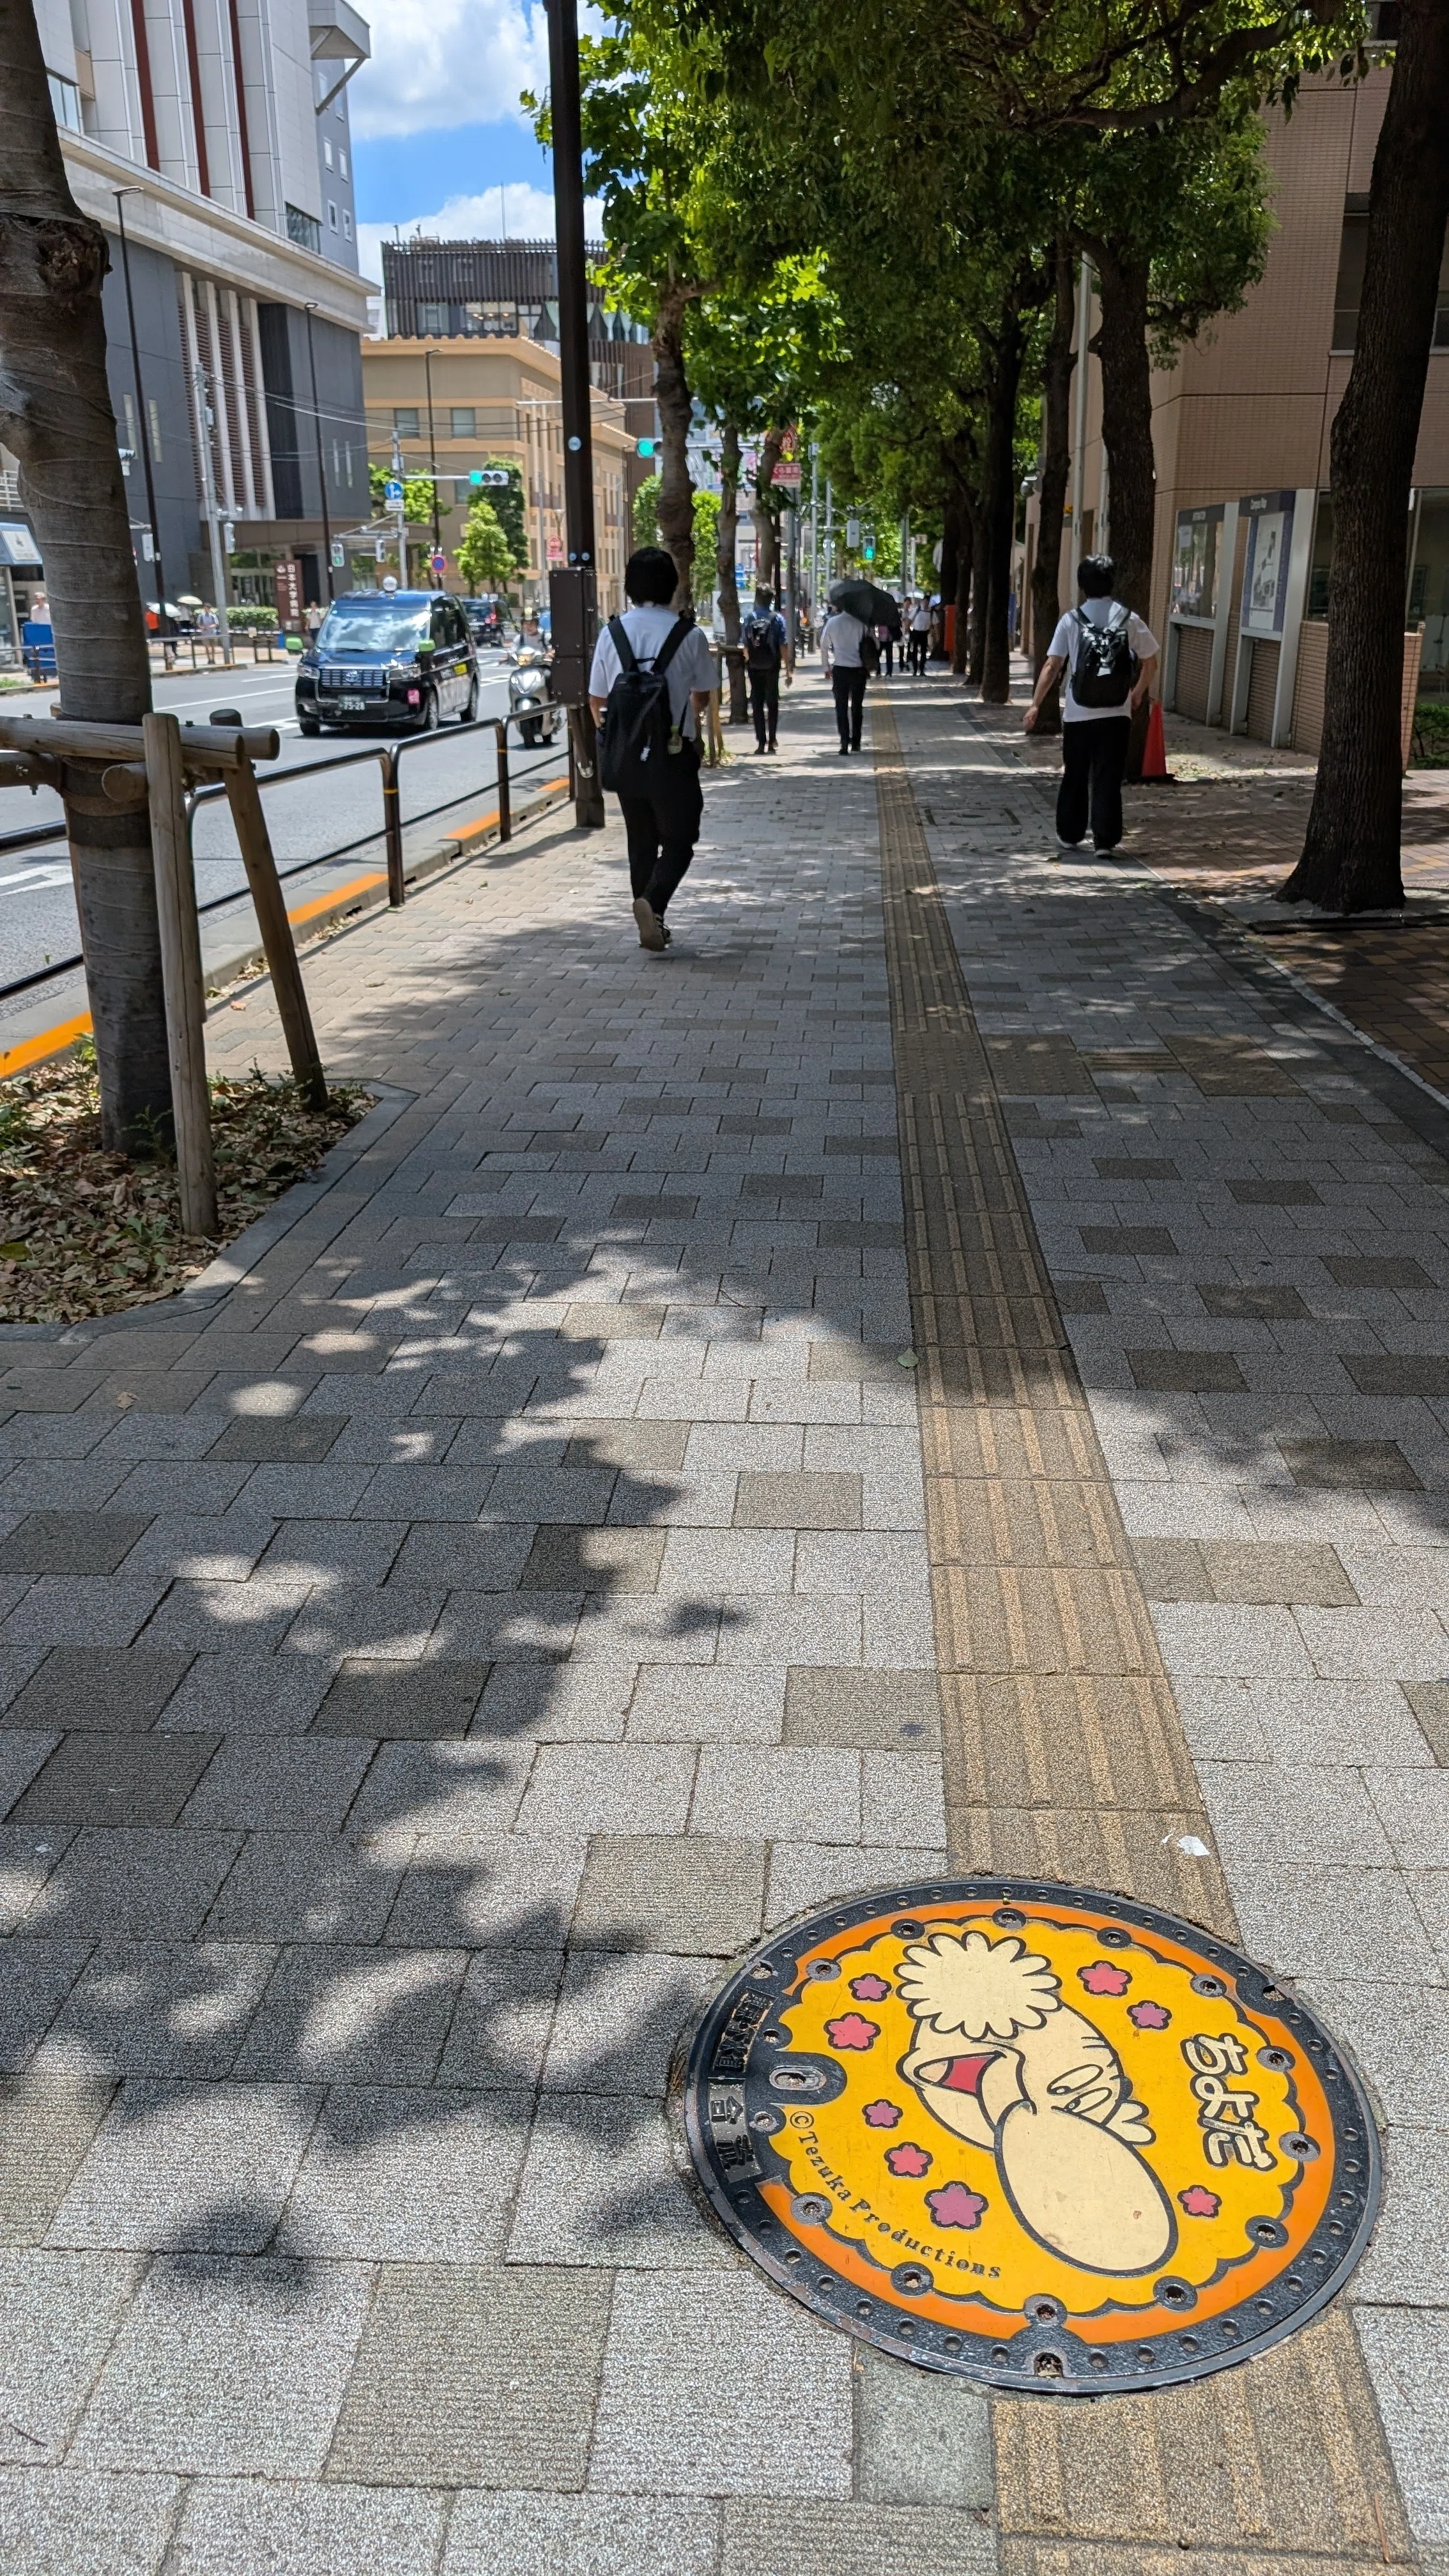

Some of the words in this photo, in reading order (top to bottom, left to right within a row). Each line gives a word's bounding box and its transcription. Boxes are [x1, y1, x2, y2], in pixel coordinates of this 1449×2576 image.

[1181, 2034, 1277, 2172] ちよだ
[849, 2198, 1002, 2279] Productions
